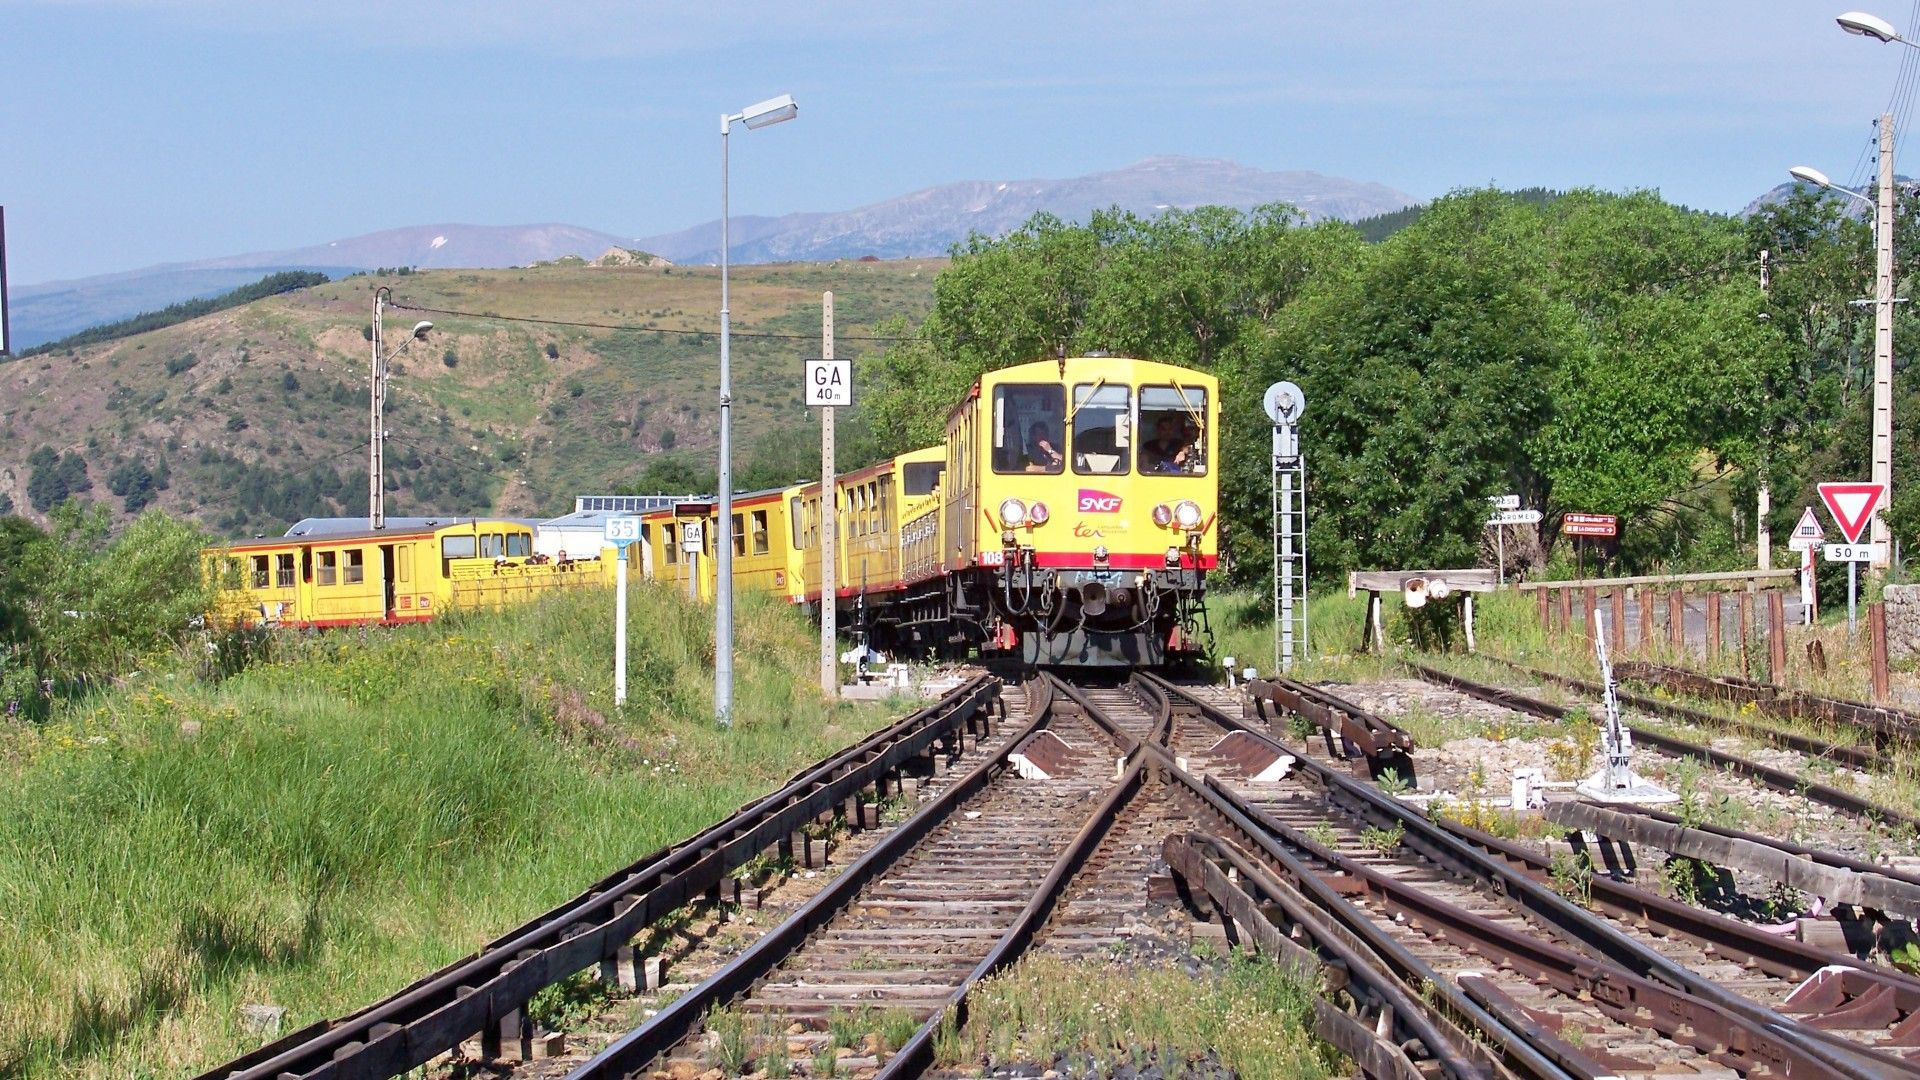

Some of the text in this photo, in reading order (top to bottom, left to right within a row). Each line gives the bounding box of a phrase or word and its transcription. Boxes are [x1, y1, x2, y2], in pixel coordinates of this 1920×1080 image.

[815, 366, 842, 386] GA
[816, 388, 833, 400] 40
[1079, 497, 1122, 511] SNCF
[611, 520, 634, 537] 35
[686, 527, 701, 539] GA
[1073, 521, 1106, 538] ter
[983, 551, 1005, 565] 108
[1835, 548, 1852, 558] 50
